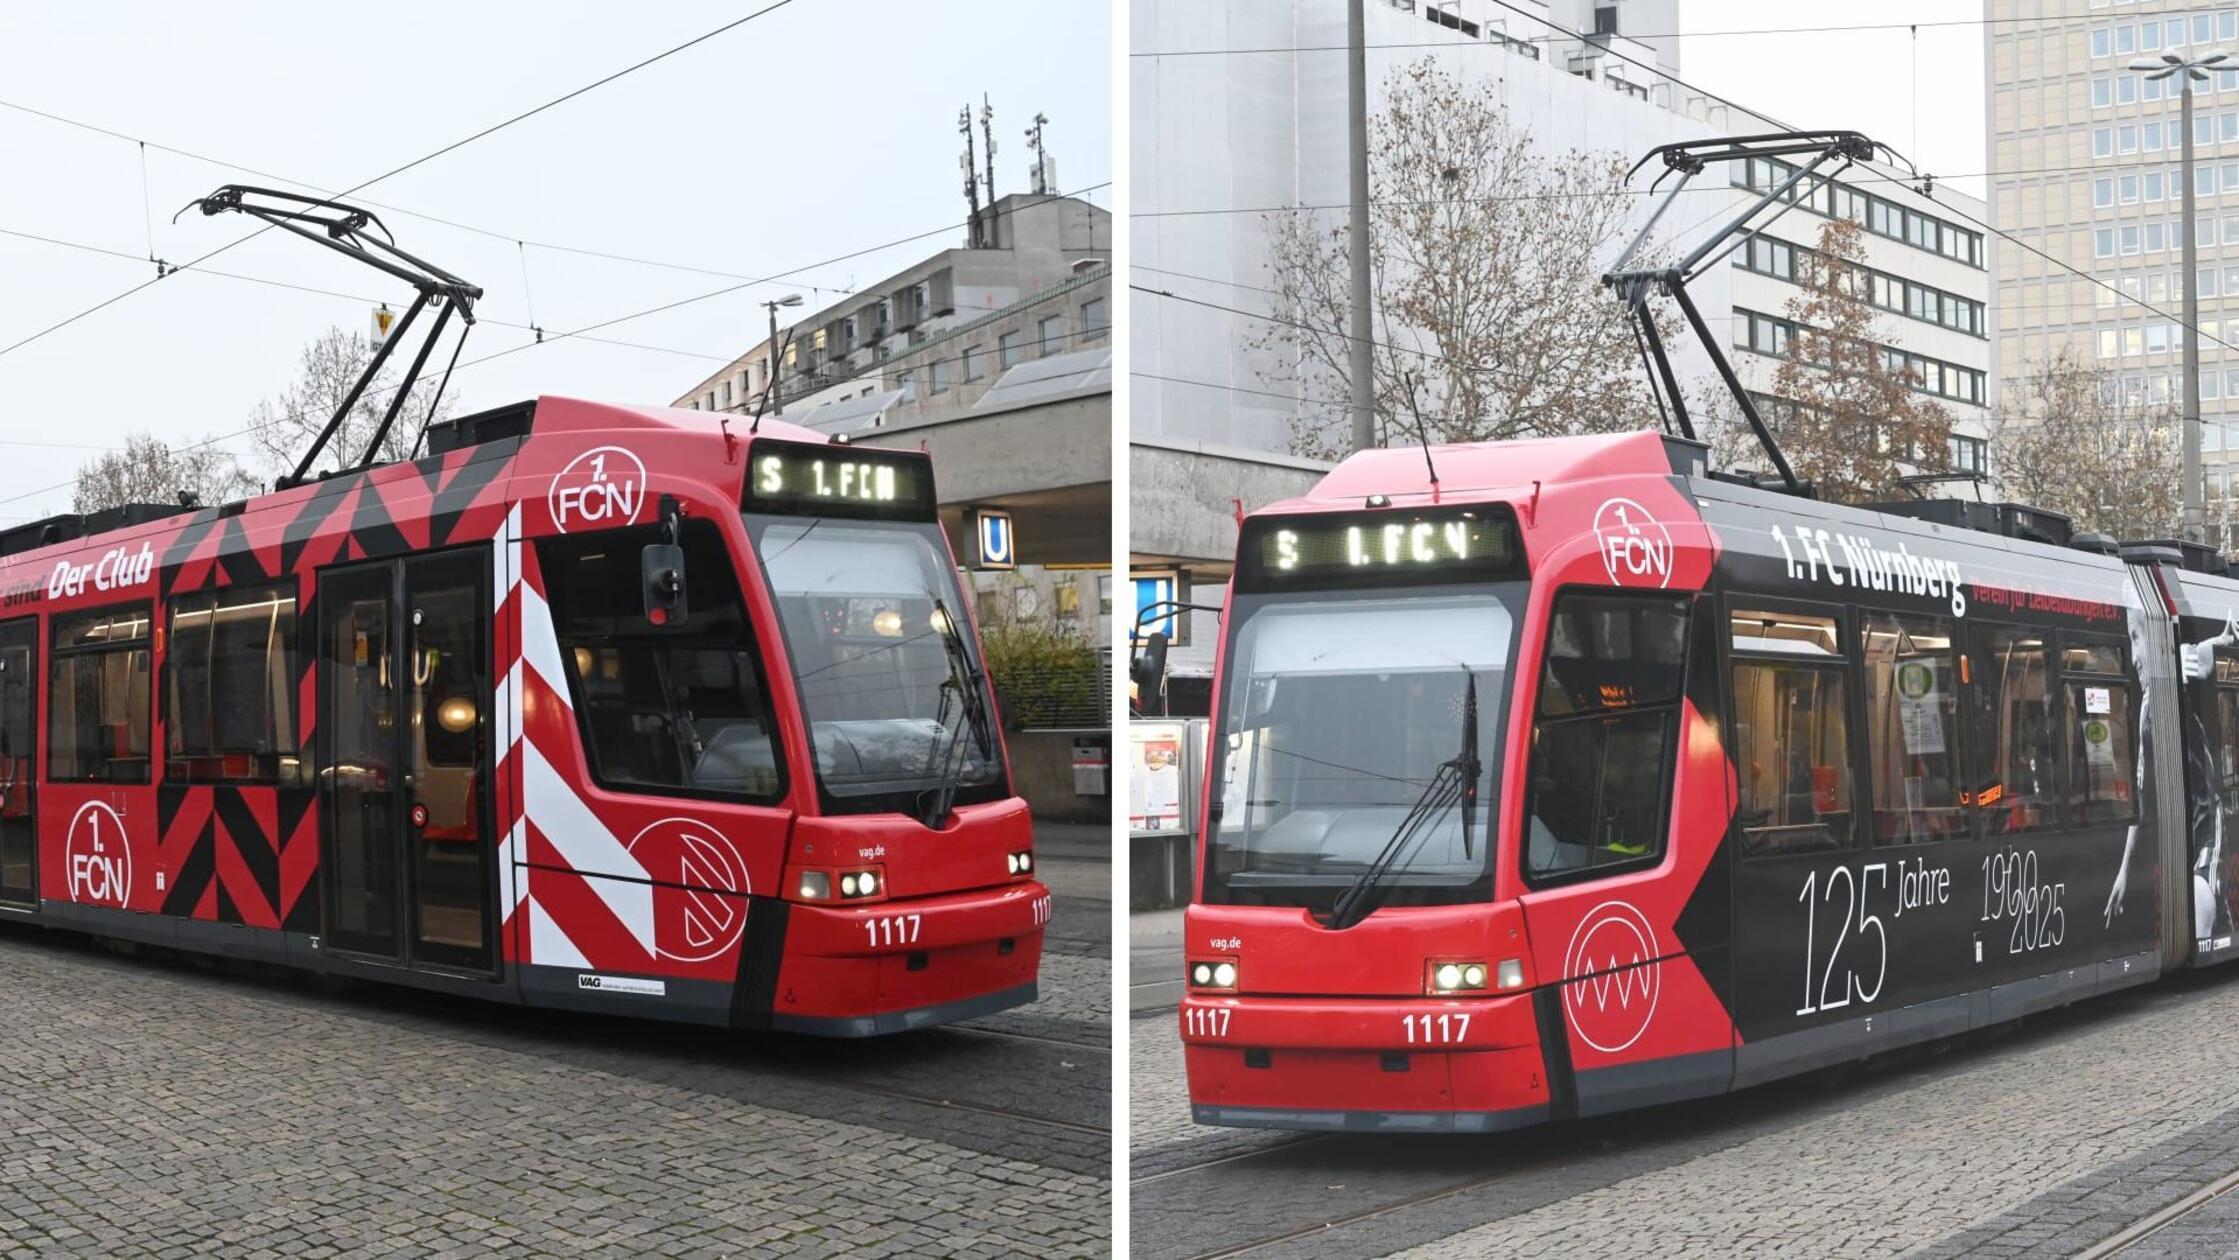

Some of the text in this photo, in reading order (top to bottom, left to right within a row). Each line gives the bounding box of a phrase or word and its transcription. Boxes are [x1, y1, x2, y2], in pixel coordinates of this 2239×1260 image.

[590, 454, 608, 482] 1.
[762, 456, 782, 493] S
[559, 480, 633, 524] FCN
[1614, 505, 1640, 535] 1.
[983, 517, 1008, 562] U
[1277, 529, 1298, 570] S
[1607, 536, 1666, 575] FCN
[48, 560, 94, 600] Der
[95, 541, 154, 591] Club
[1836, 533, 1966, 618] Nürnberg
[88, 810, 104, 852] 1.
[859, 844, 886, 859] vag.de
[73, 854, 123, 902] FCN
[865, 914, 921, 947] 1117
[1210, 936, 1241, 950] vag.de
[1796, 857, 1950, 1016] 125 Jahre
[580, 977, 601, 988] VAG
[1186, 1009, 1231, 1036] 1117
[1402, 1014, 1470, 1042] 1117
